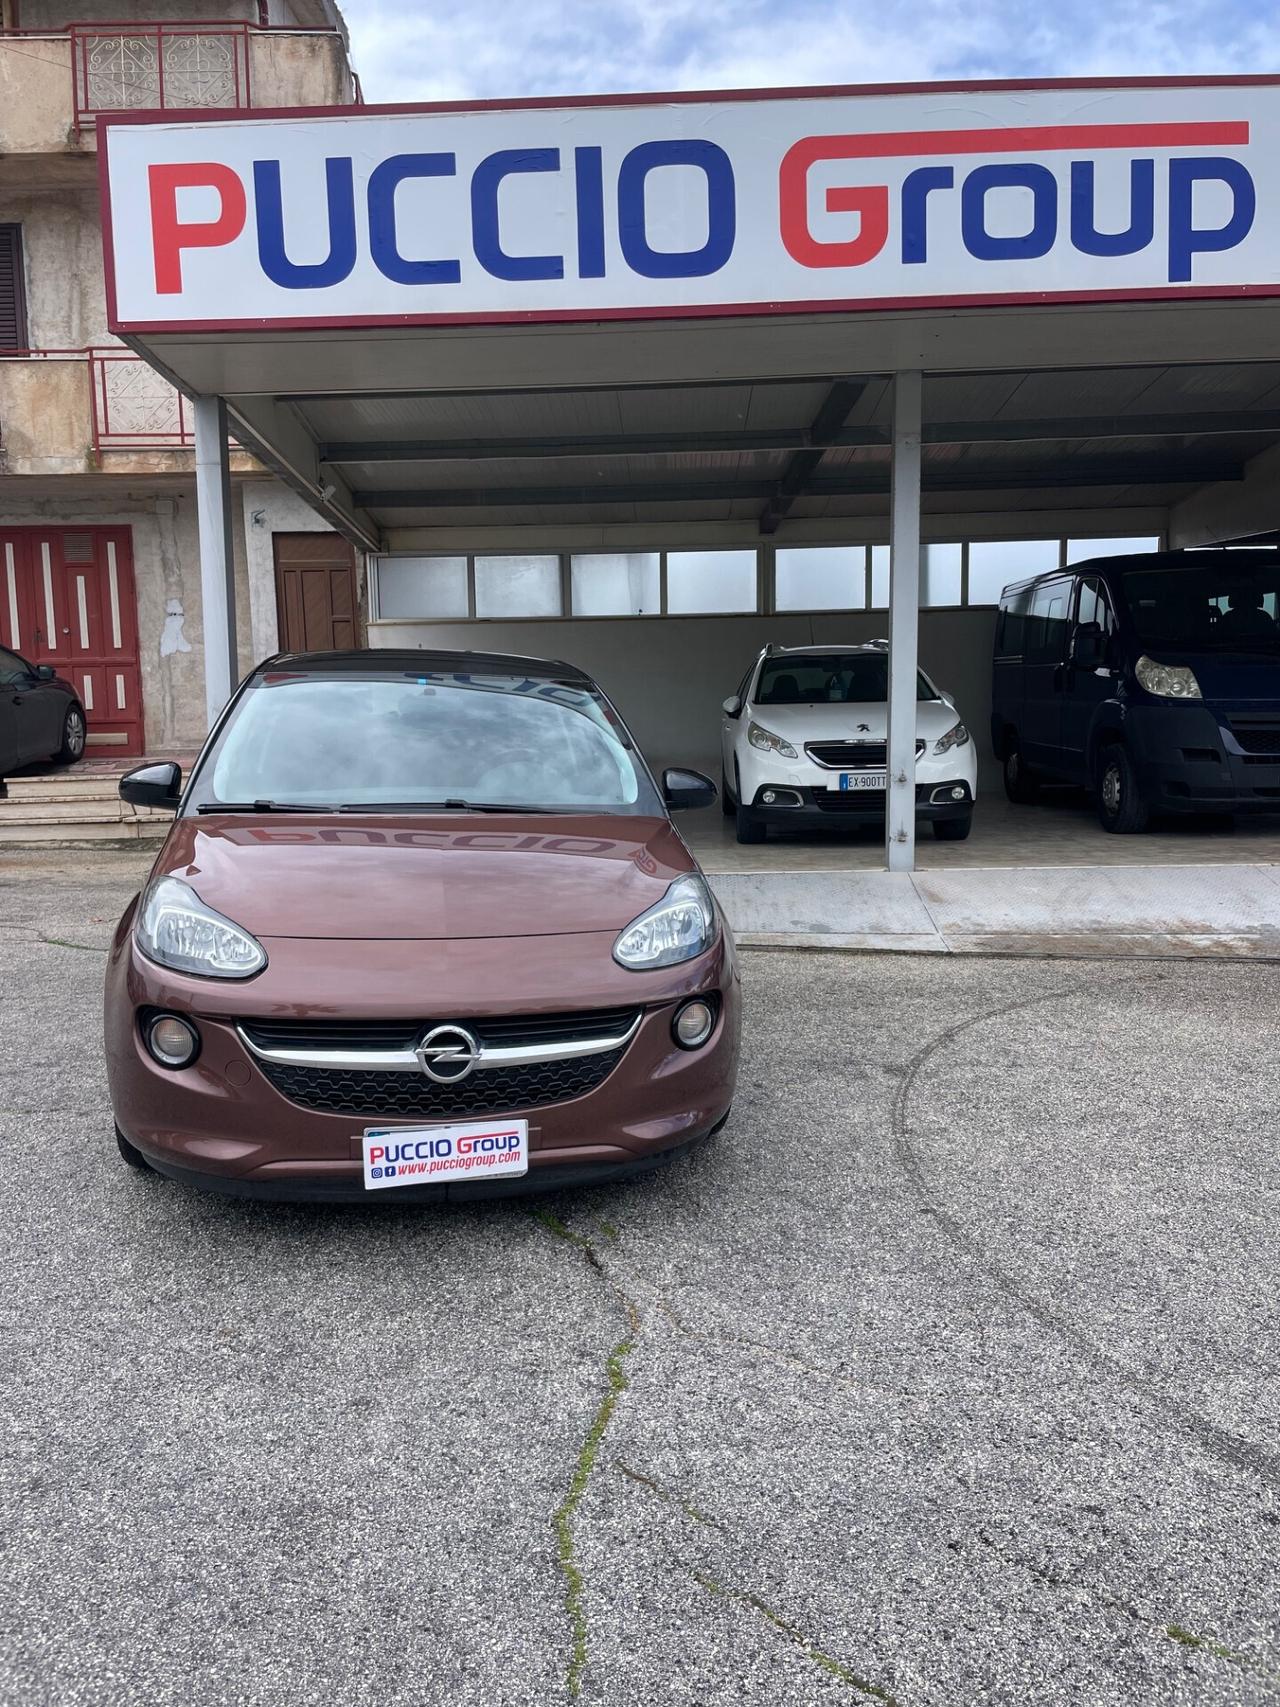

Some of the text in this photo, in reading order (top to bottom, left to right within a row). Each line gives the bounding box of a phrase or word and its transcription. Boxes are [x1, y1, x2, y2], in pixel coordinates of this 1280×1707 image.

[148, 121, 1256, 294] PUCCIO Group
[370, 1131, 520, 1164] PUCCIO Group
[398, 1151, 520, 1176] www.pucciogroup.com
